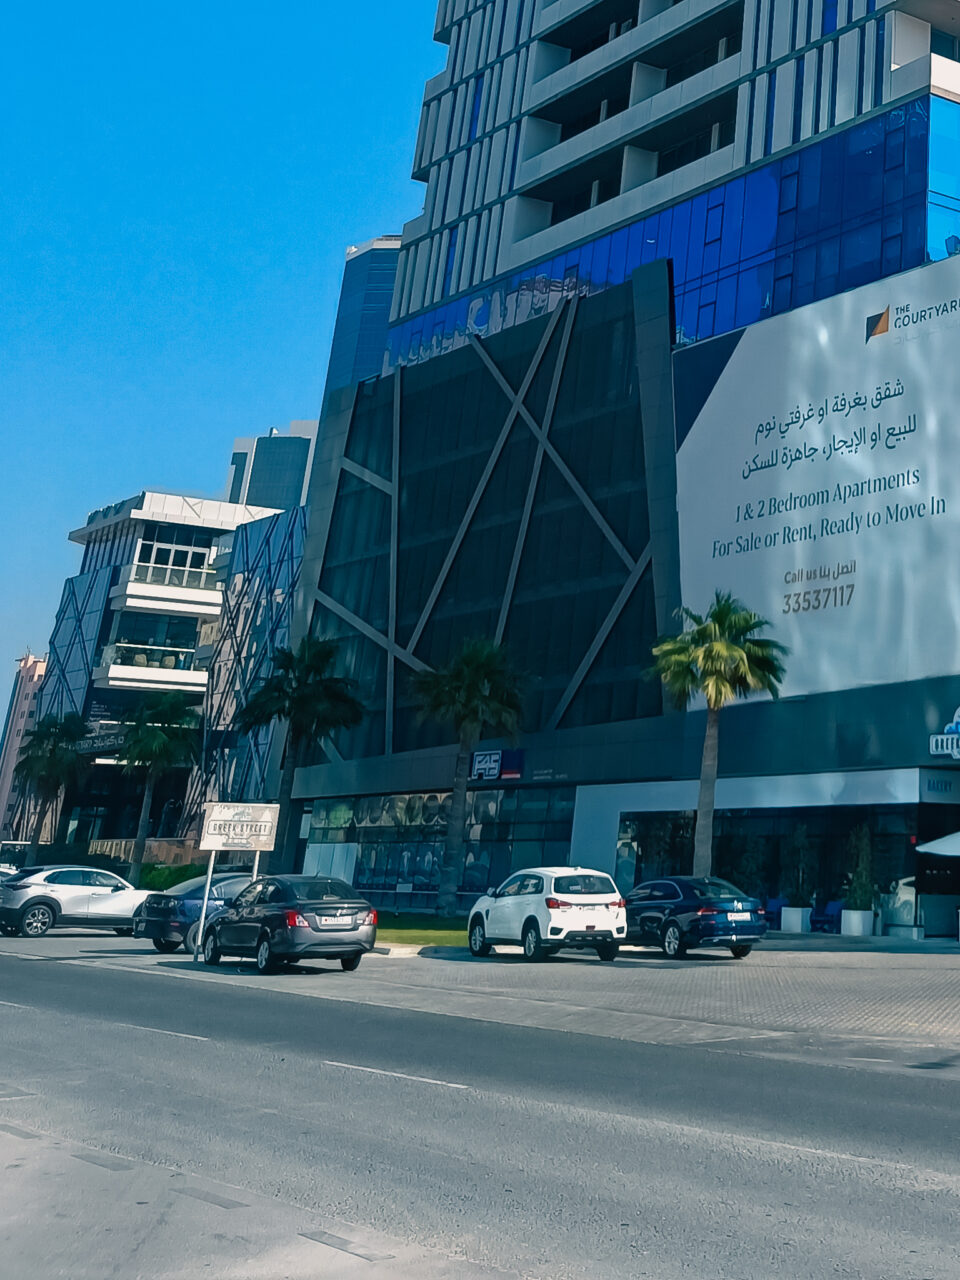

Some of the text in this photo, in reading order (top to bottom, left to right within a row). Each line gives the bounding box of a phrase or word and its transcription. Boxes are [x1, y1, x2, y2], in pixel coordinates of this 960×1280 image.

[895, 303, 911, 315] THE
[832, 392, 868, 417] بغرفة
[871, 379, 904, 409] شقق
[755, 416, 776, 445] نوم
[779, 404, 815, 439] غرفتي
[885, 414, 917, 449] للبيع
[742, 449, 778, 480] للسكن
[782, 442, 819, 470] جاهزة
[736, 469, 920, 523] 1 & 2 Bedroom Apartments
[712, 495, 946, 558] For Sale or Rent, Ready to Move In
[784, 567, 817, 584] Call us
[782, 584, 855, 615] 33537117
[472, 751, 501, 778] F45
[213, 823, 267, 833] GREEK STREET
